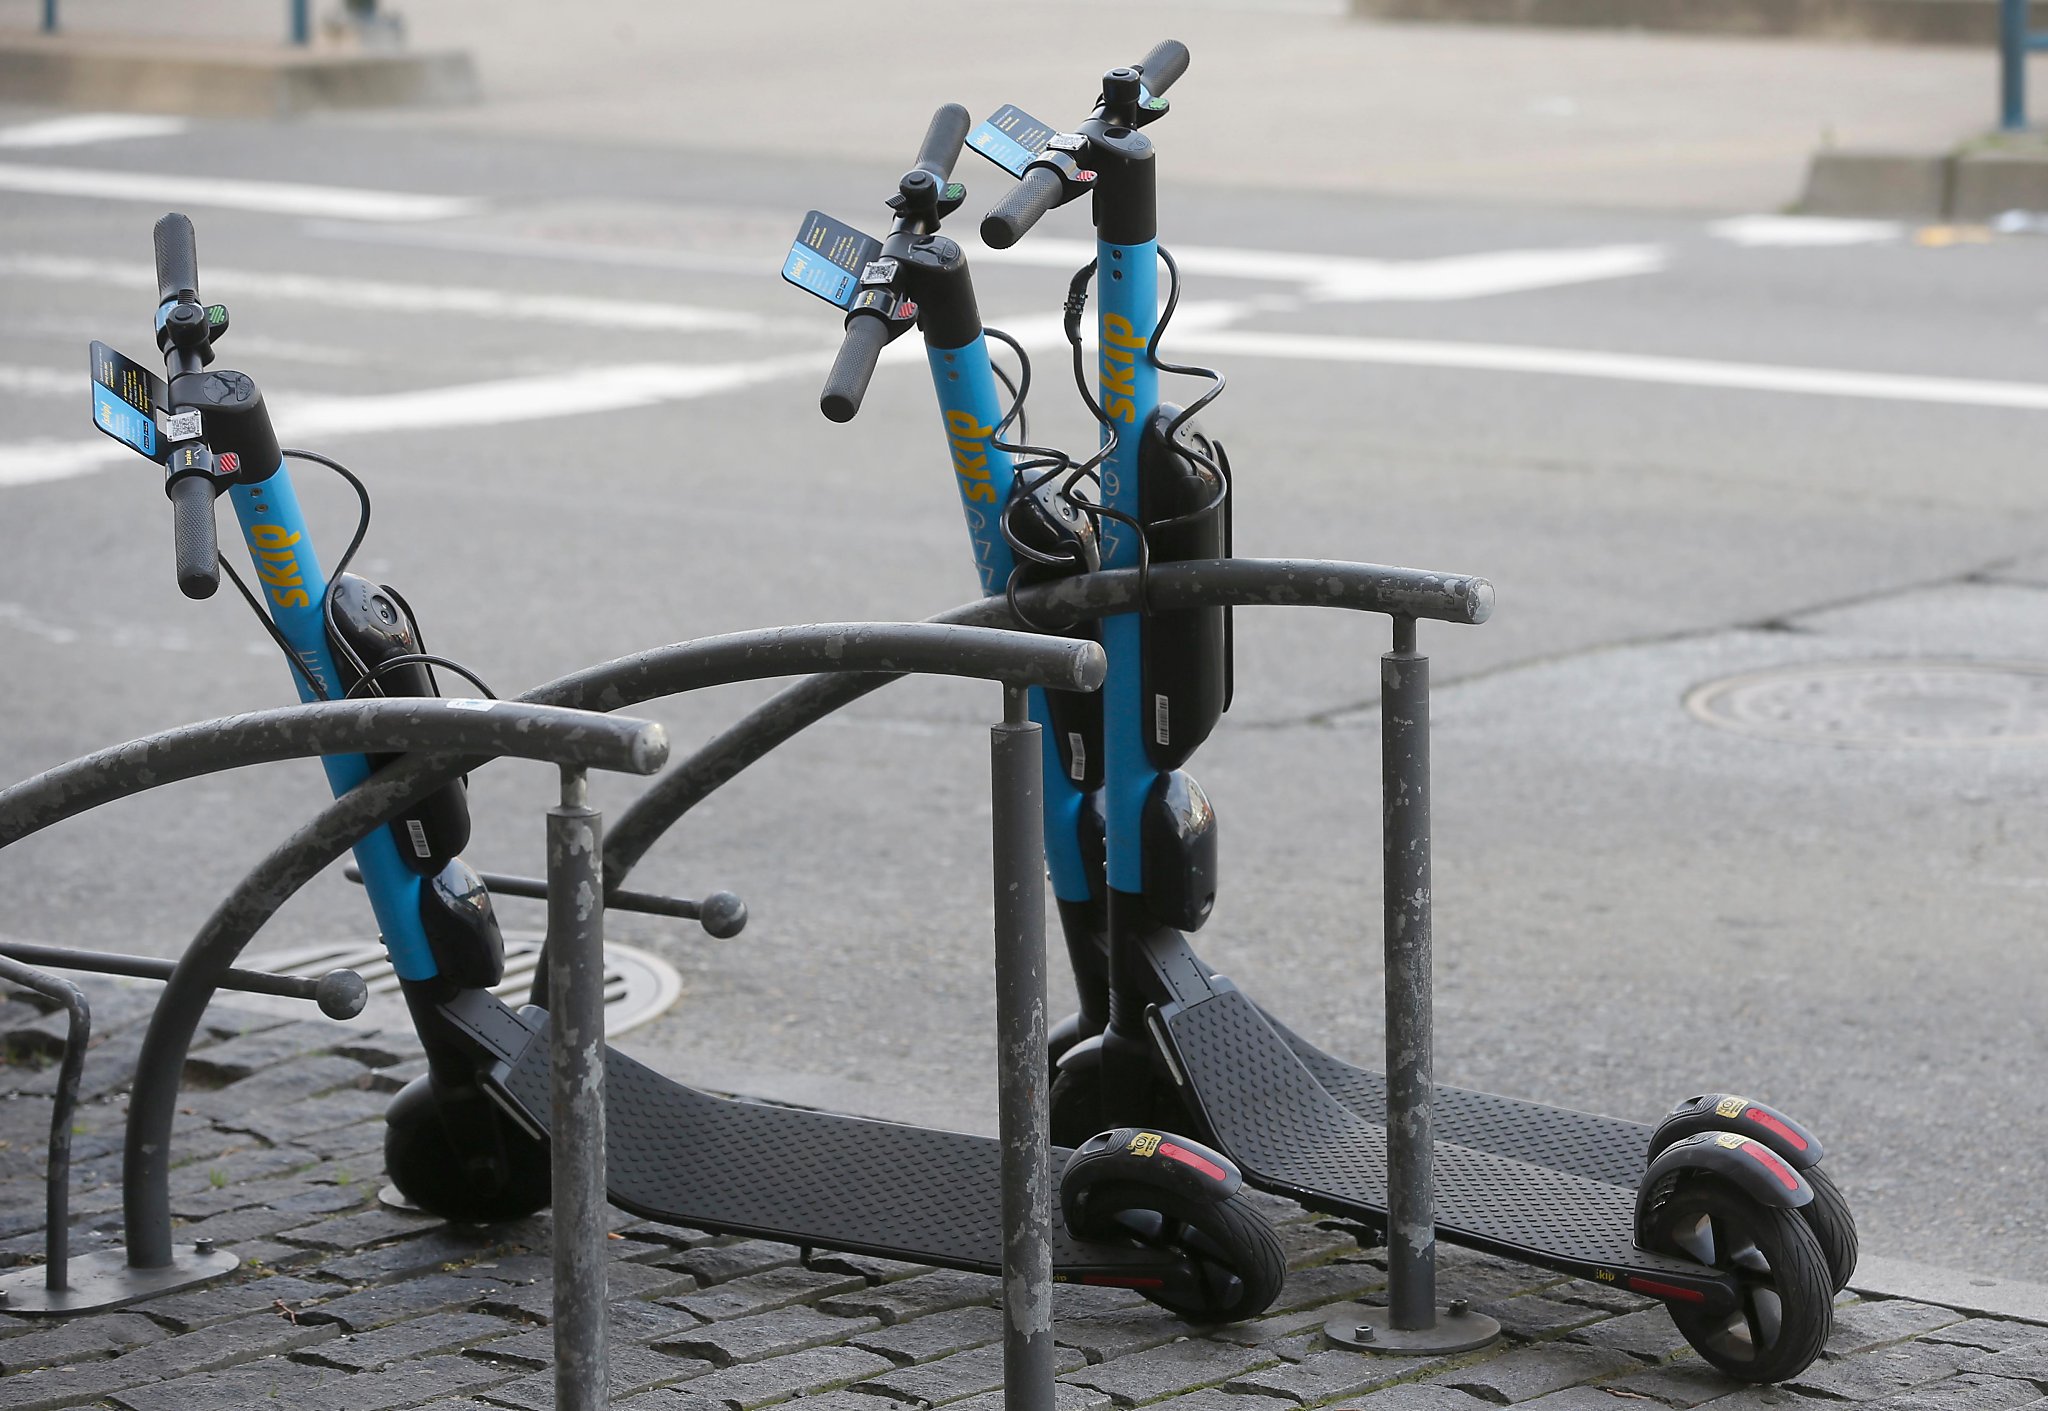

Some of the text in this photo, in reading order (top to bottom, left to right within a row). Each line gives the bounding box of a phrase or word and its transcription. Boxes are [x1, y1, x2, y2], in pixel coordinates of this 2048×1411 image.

[1098, 313, 1146, 423] skip
[947, 410, 996, 503] skip
[249, 524, 310, 608] skip
